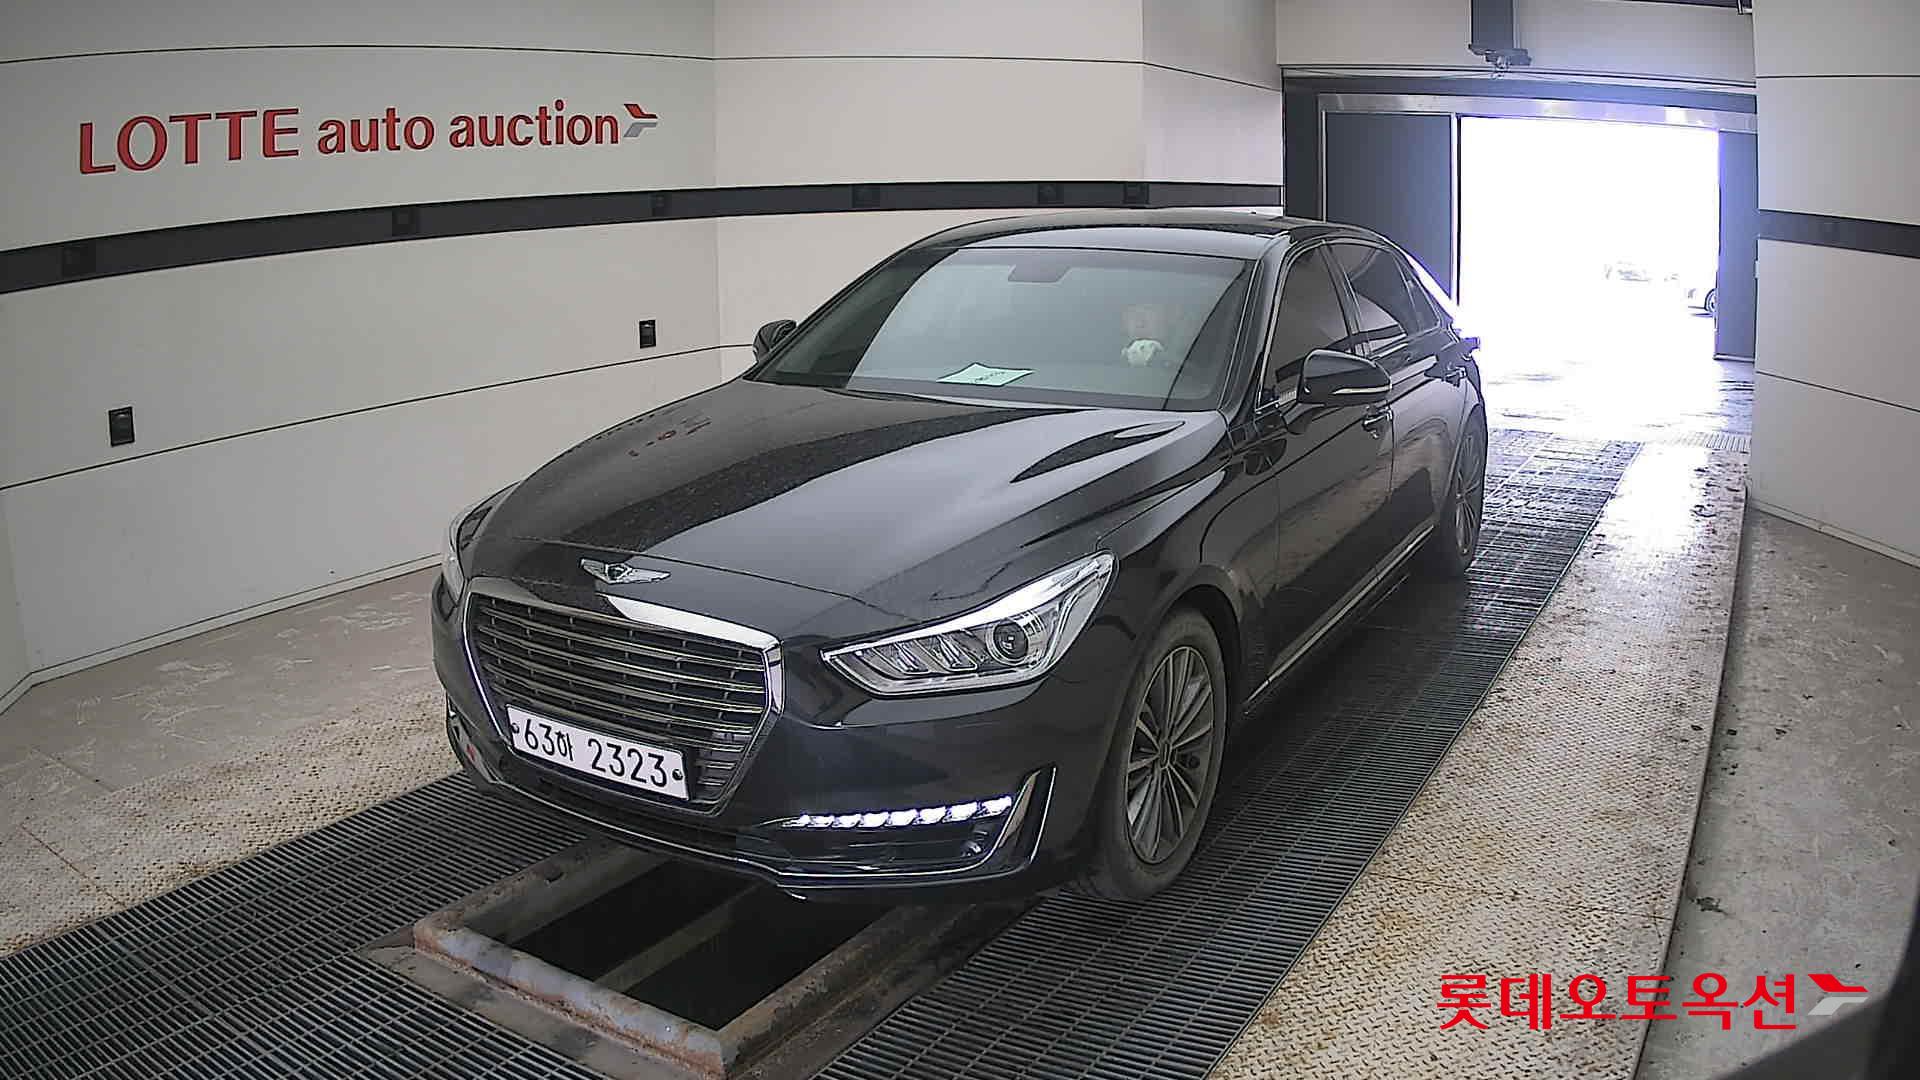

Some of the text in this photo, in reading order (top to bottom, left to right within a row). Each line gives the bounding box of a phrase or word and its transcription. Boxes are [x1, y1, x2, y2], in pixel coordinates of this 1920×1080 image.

[80, 100, 620, 174] LOTTE auto auction
[524, 718, 668, 788] 63하 2323
